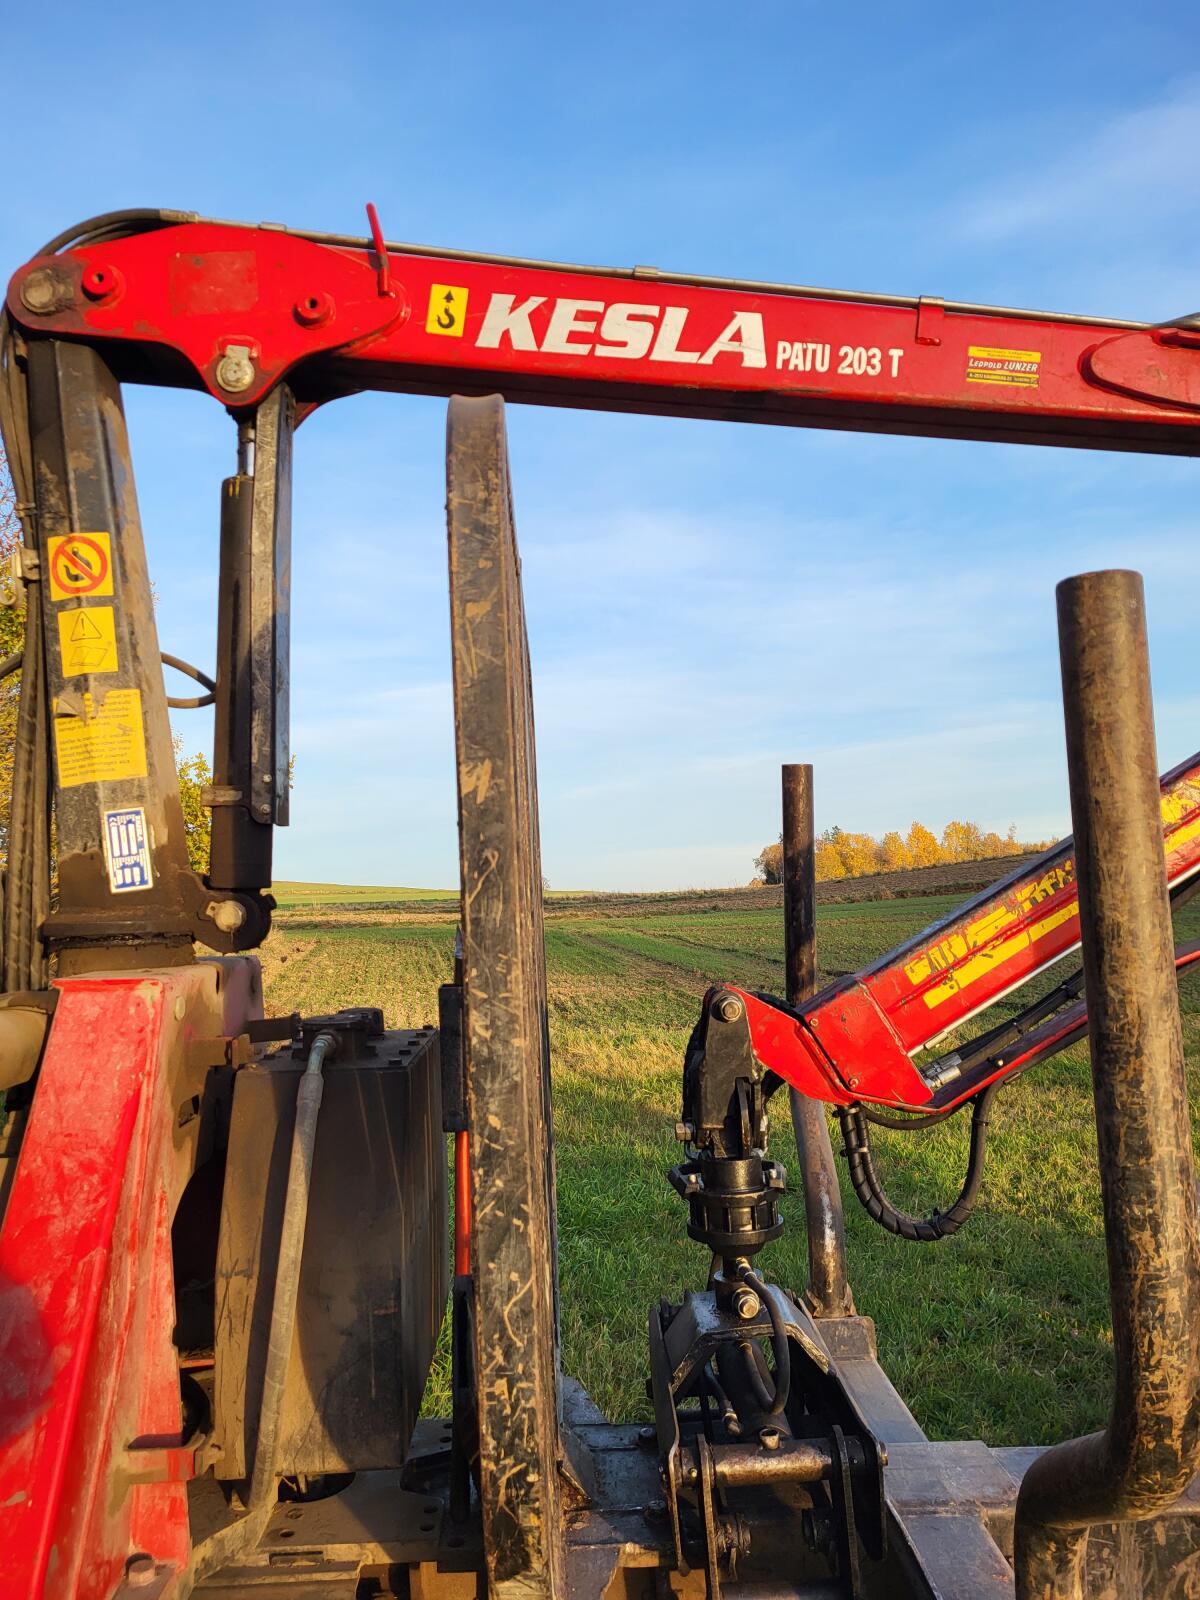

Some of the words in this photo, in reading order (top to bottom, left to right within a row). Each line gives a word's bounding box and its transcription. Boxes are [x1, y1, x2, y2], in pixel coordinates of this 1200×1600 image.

[475, 293, 767, 368] KESLA
[775, 340, 831, 372] PATU
[837, 346, 881, 376] 203
[888, 349, 904, 378] T
[1004, 361, 1037, 371] LUNZER
